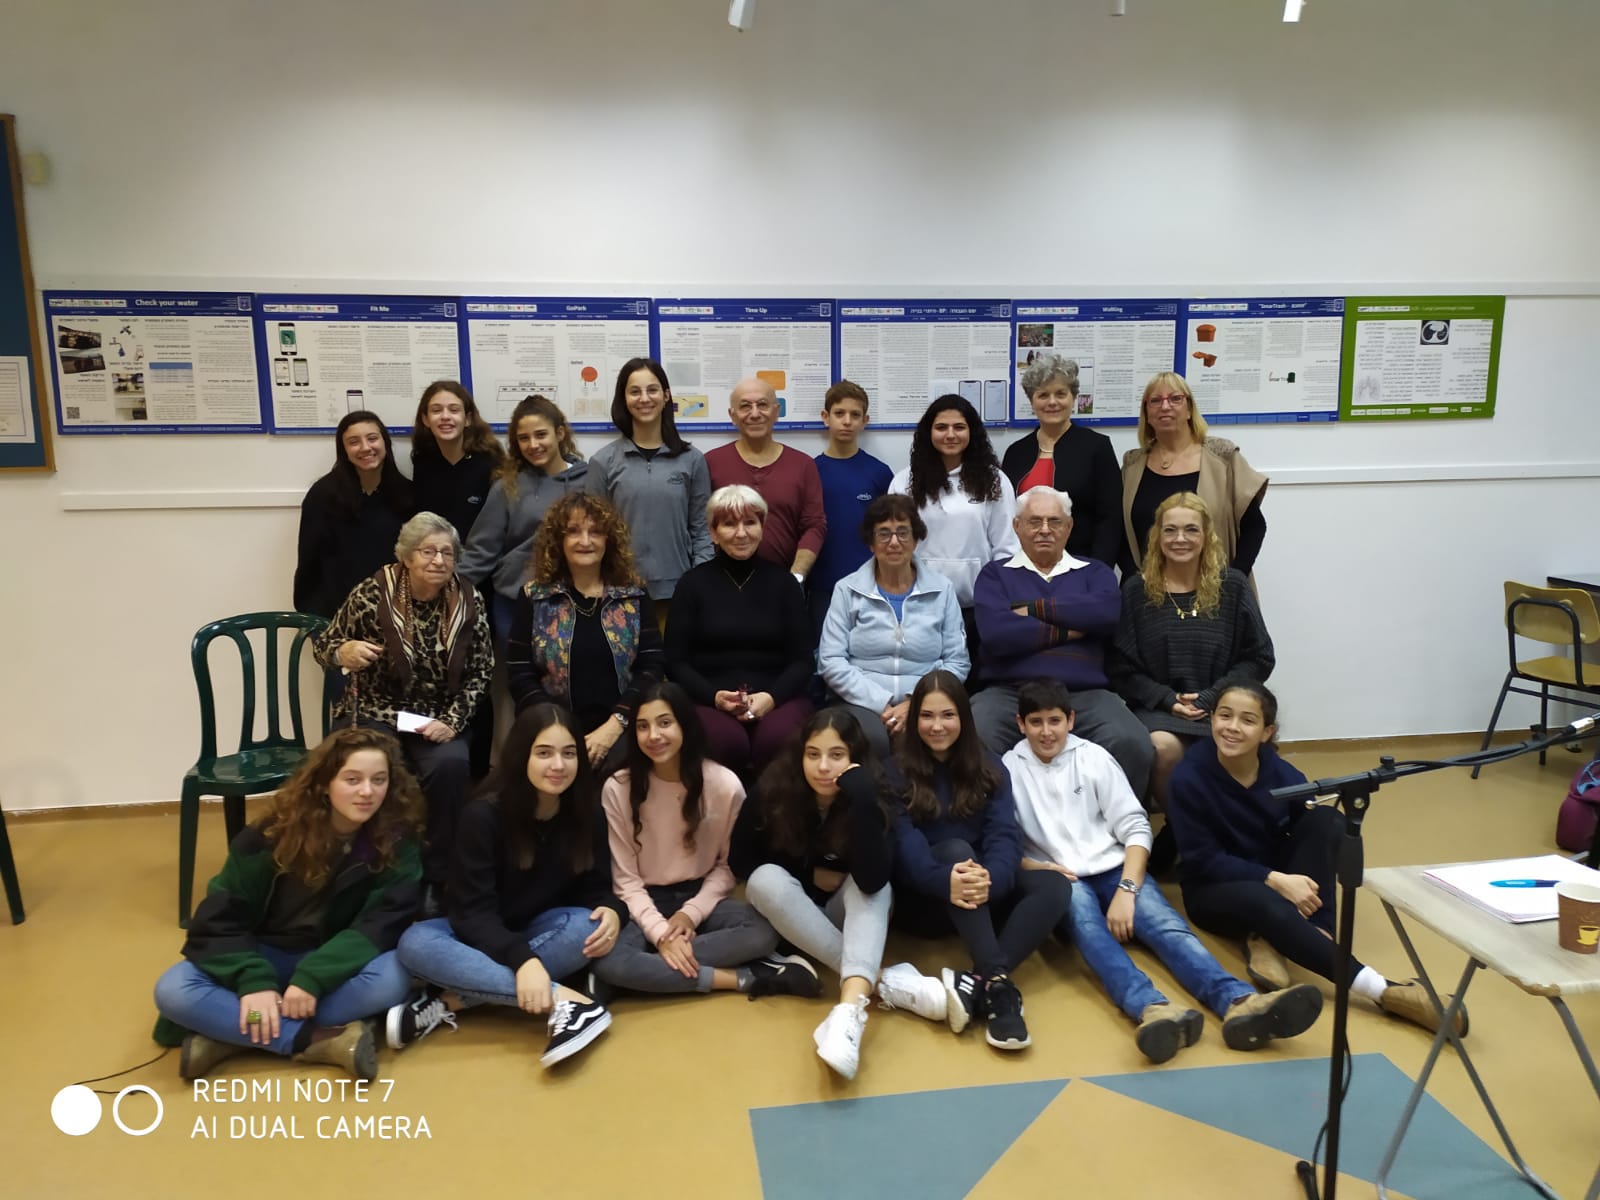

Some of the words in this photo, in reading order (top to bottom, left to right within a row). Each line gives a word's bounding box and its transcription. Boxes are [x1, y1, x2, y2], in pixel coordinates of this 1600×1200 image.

[134, 298, 157, 306] Check
[158, 300, 176, 308] your
[177, 299, 199, 307] water
